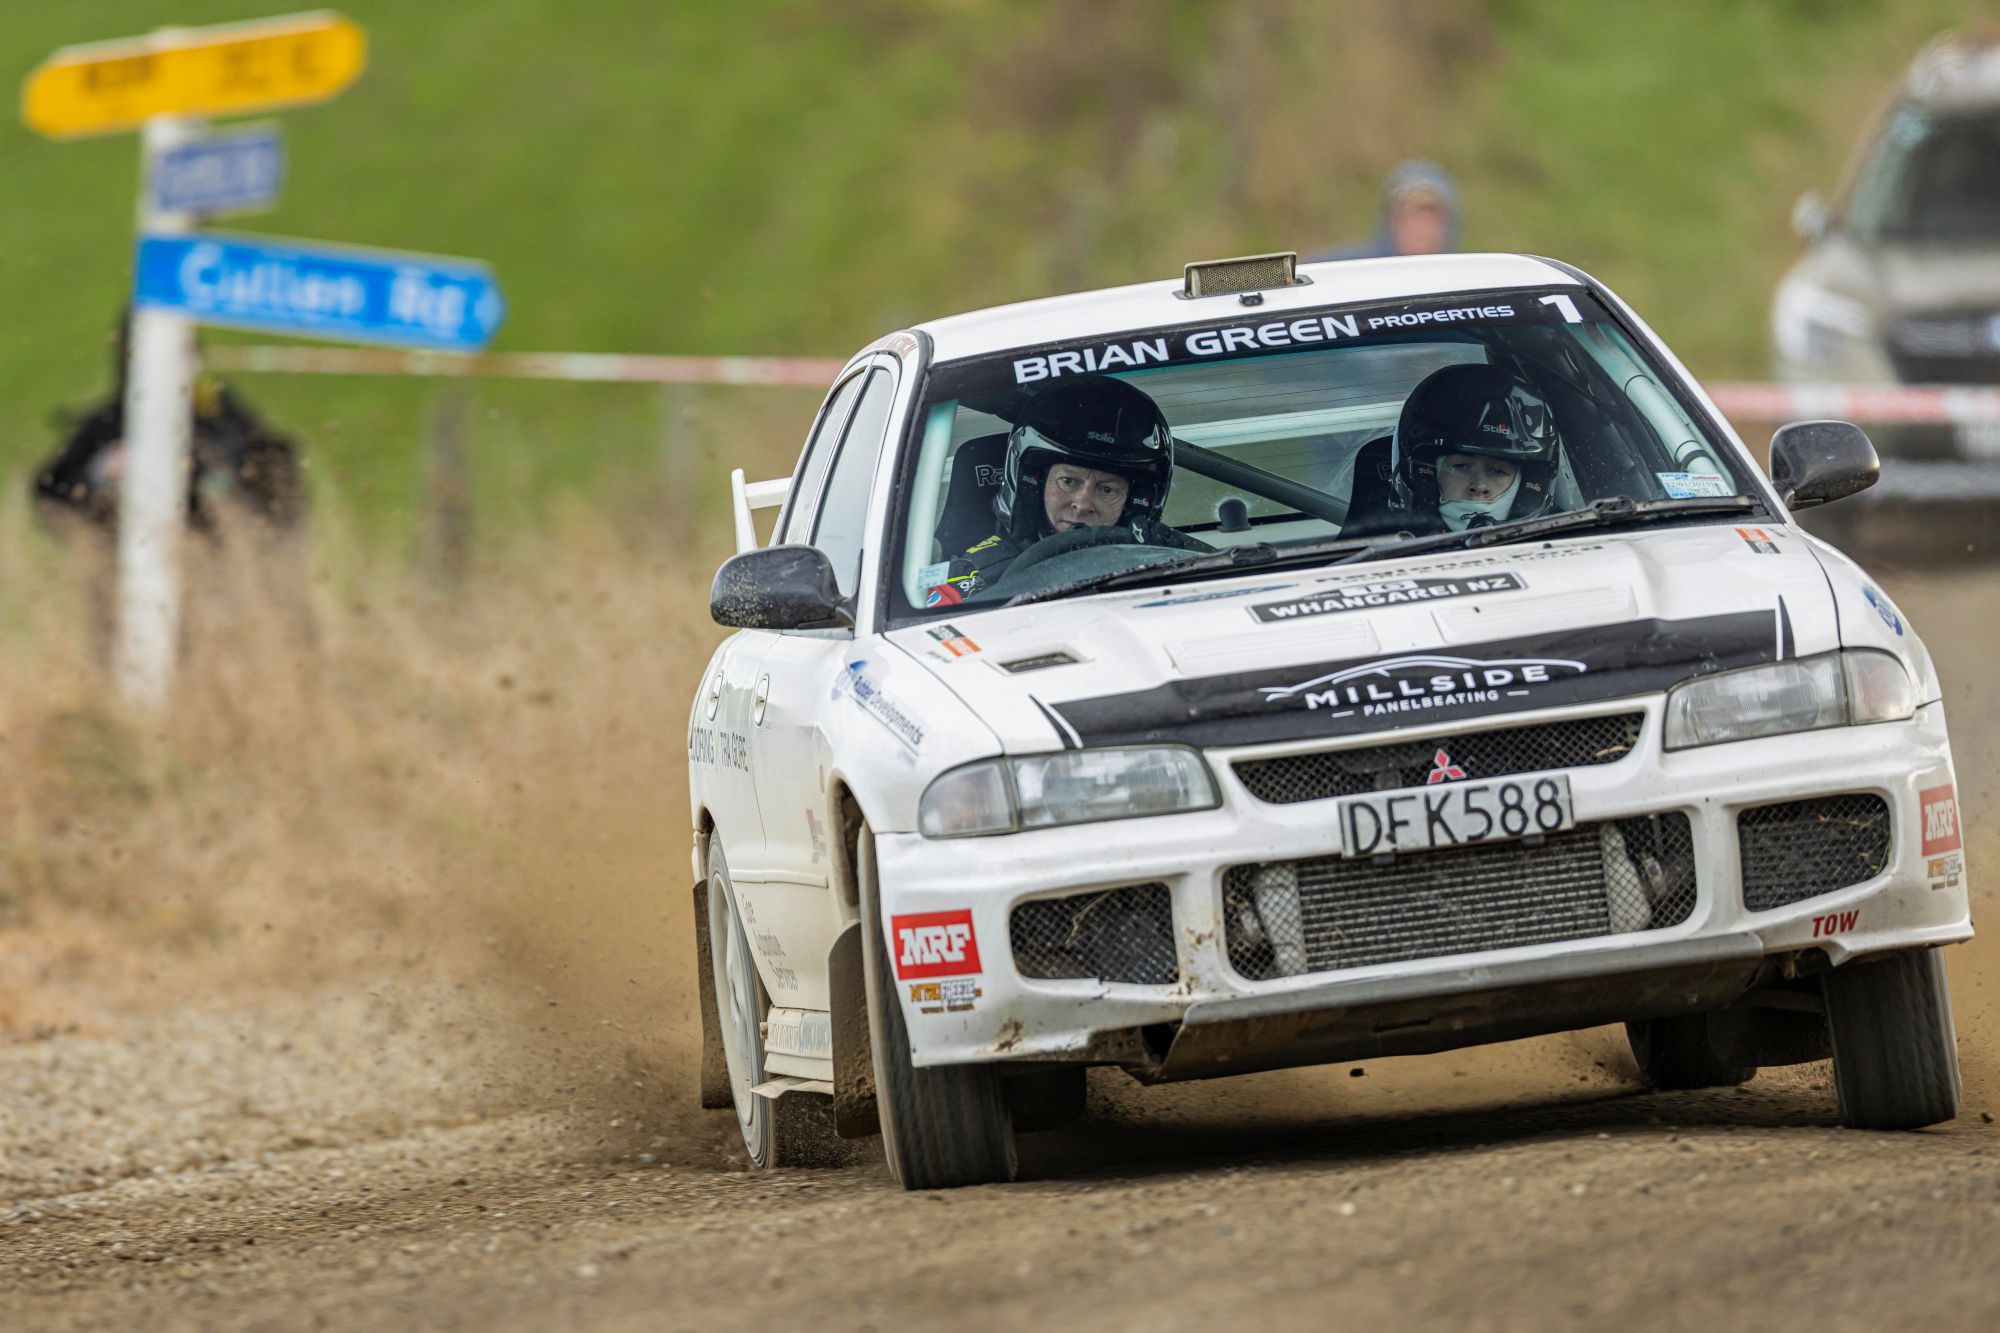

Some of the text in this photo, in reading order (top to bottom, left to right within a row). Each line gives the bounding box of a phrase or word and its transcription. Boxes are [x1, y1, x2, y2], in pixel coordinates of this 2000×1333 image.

[1538, 294, 1583, 324] 1
[1012, 304, 1515, 385] BRIAN GREEN PROPERTIES
[1087, 430, 1115, 443] Stilo
[1269, 584, 1459, 619] WHANGAREI
[1467, 577, 1511, 593] NZ
[1305, 665, 1549, 709] MILLSIDE
[1363, 690, 1499, 716] PANELBEATING
[1350, 778, 1563, 856] DFK588
[1924, 799, 1957, 841] MRF
[899, 922, 971, 966] MRF
[1812, 910, 1859, 938] TOW
